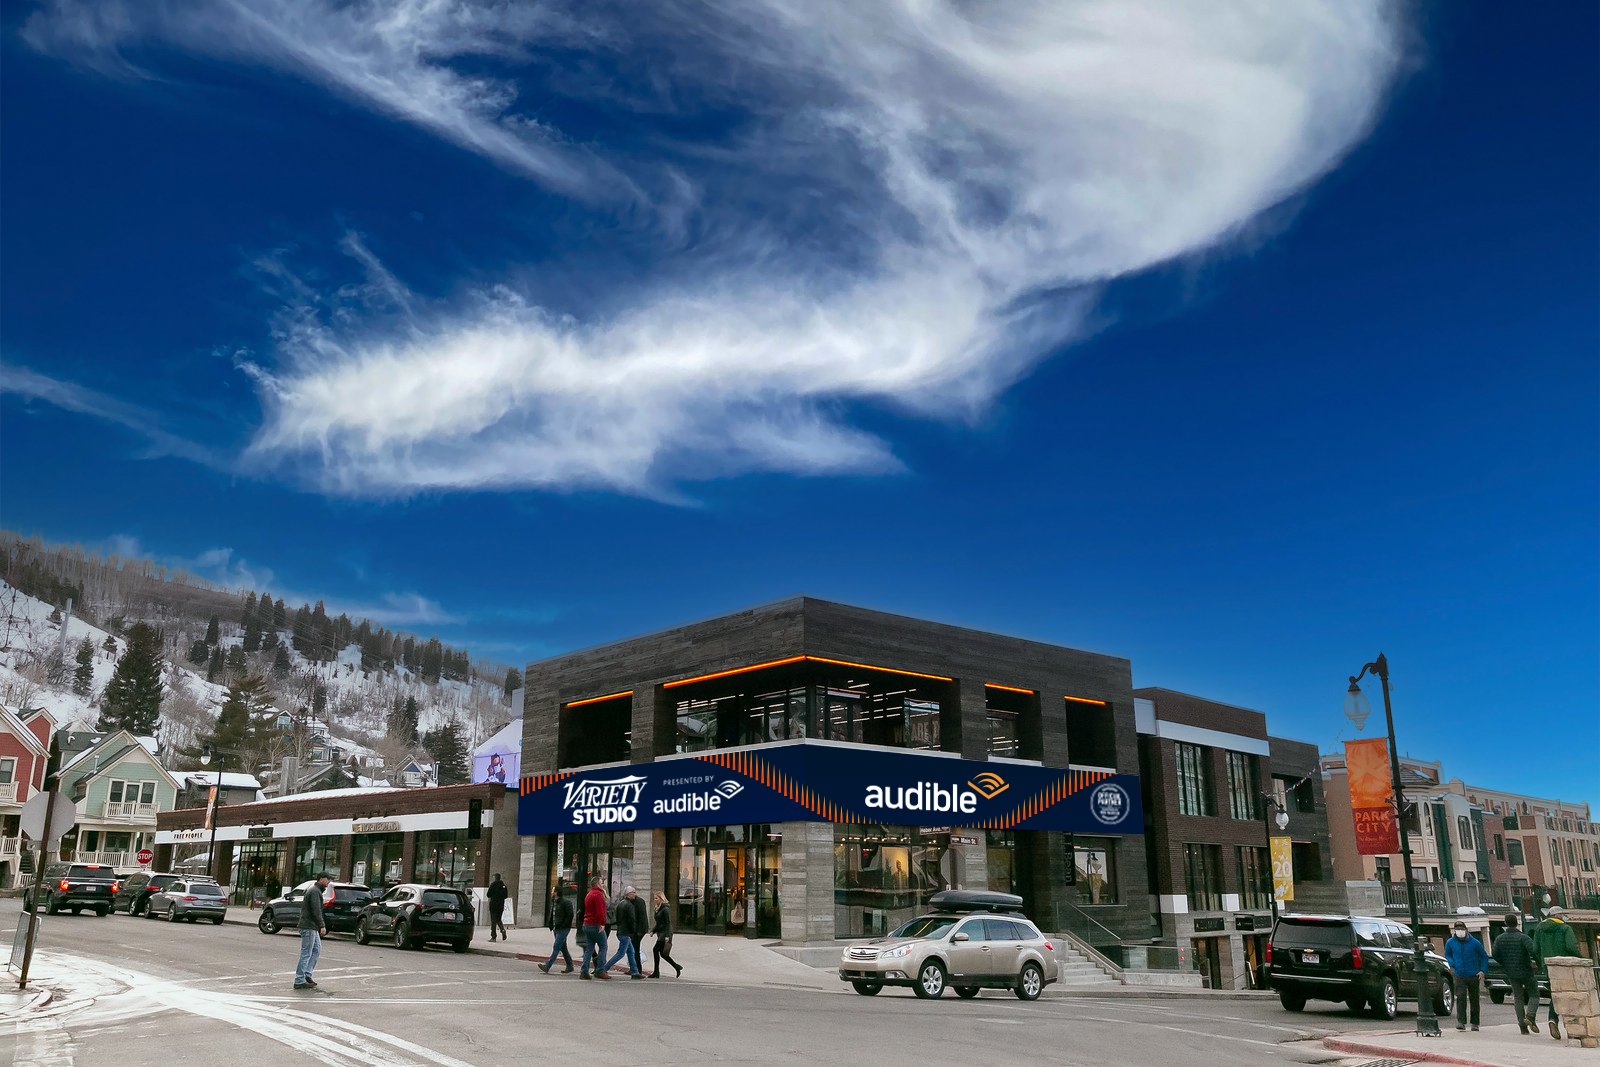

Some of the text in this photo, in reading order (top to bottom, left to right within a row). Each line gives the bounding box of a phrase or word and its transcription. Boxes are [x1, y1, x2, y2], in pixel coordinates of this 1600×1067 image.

[663, 775, 714, 786] PRESENTED BY
[563, 775, 648, 810] VARIETY
[865, 781, 977, 813] audible
[653, 791, 721, 814] audible
[573, 805, 637, 825] STUDIO
[1355, 811, 1390, 822] PARK
[1356, 822, 1391, 833] CITY
[1273, 860, 1292, 878] 20
